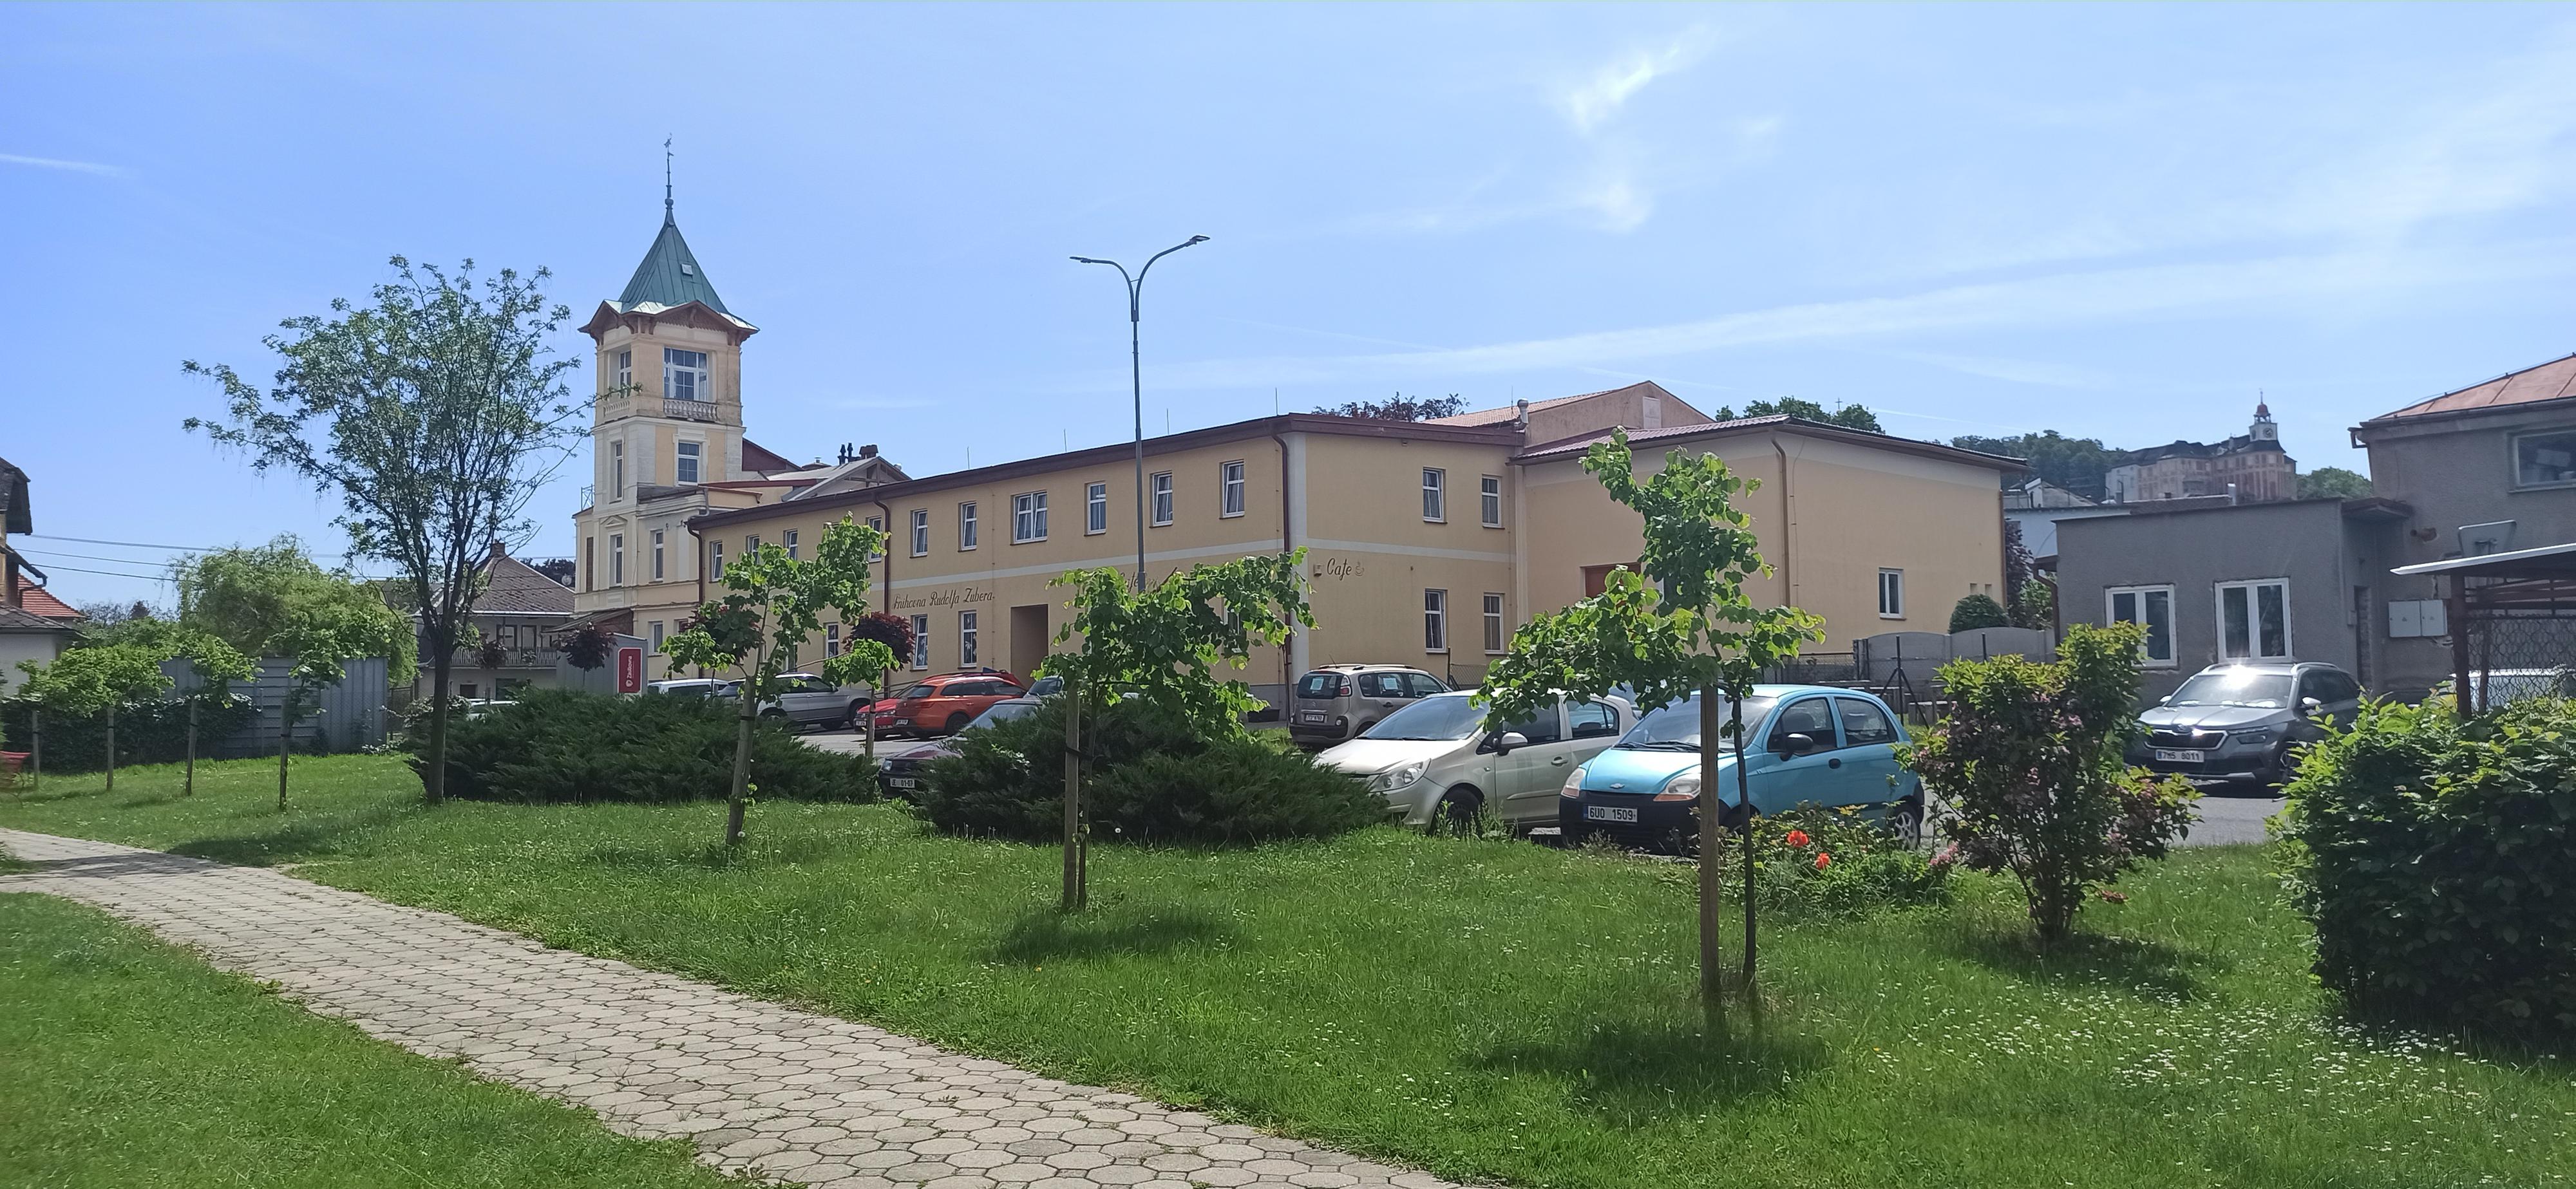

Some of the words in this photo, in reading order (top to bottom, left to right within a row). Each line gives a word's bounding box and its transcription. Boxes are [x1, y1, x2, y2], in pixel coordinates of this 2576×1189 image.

[1327, 557, 1352, 581] Cafe
[893, 594, 926, 610] Knihovna
[929, 589, 960, 609] Rudolfa
[963, 586, 992, 603] Zubera
[1589, 807, 1605, 819] 6U0
[1612, 809, 1633, 821] 1509
